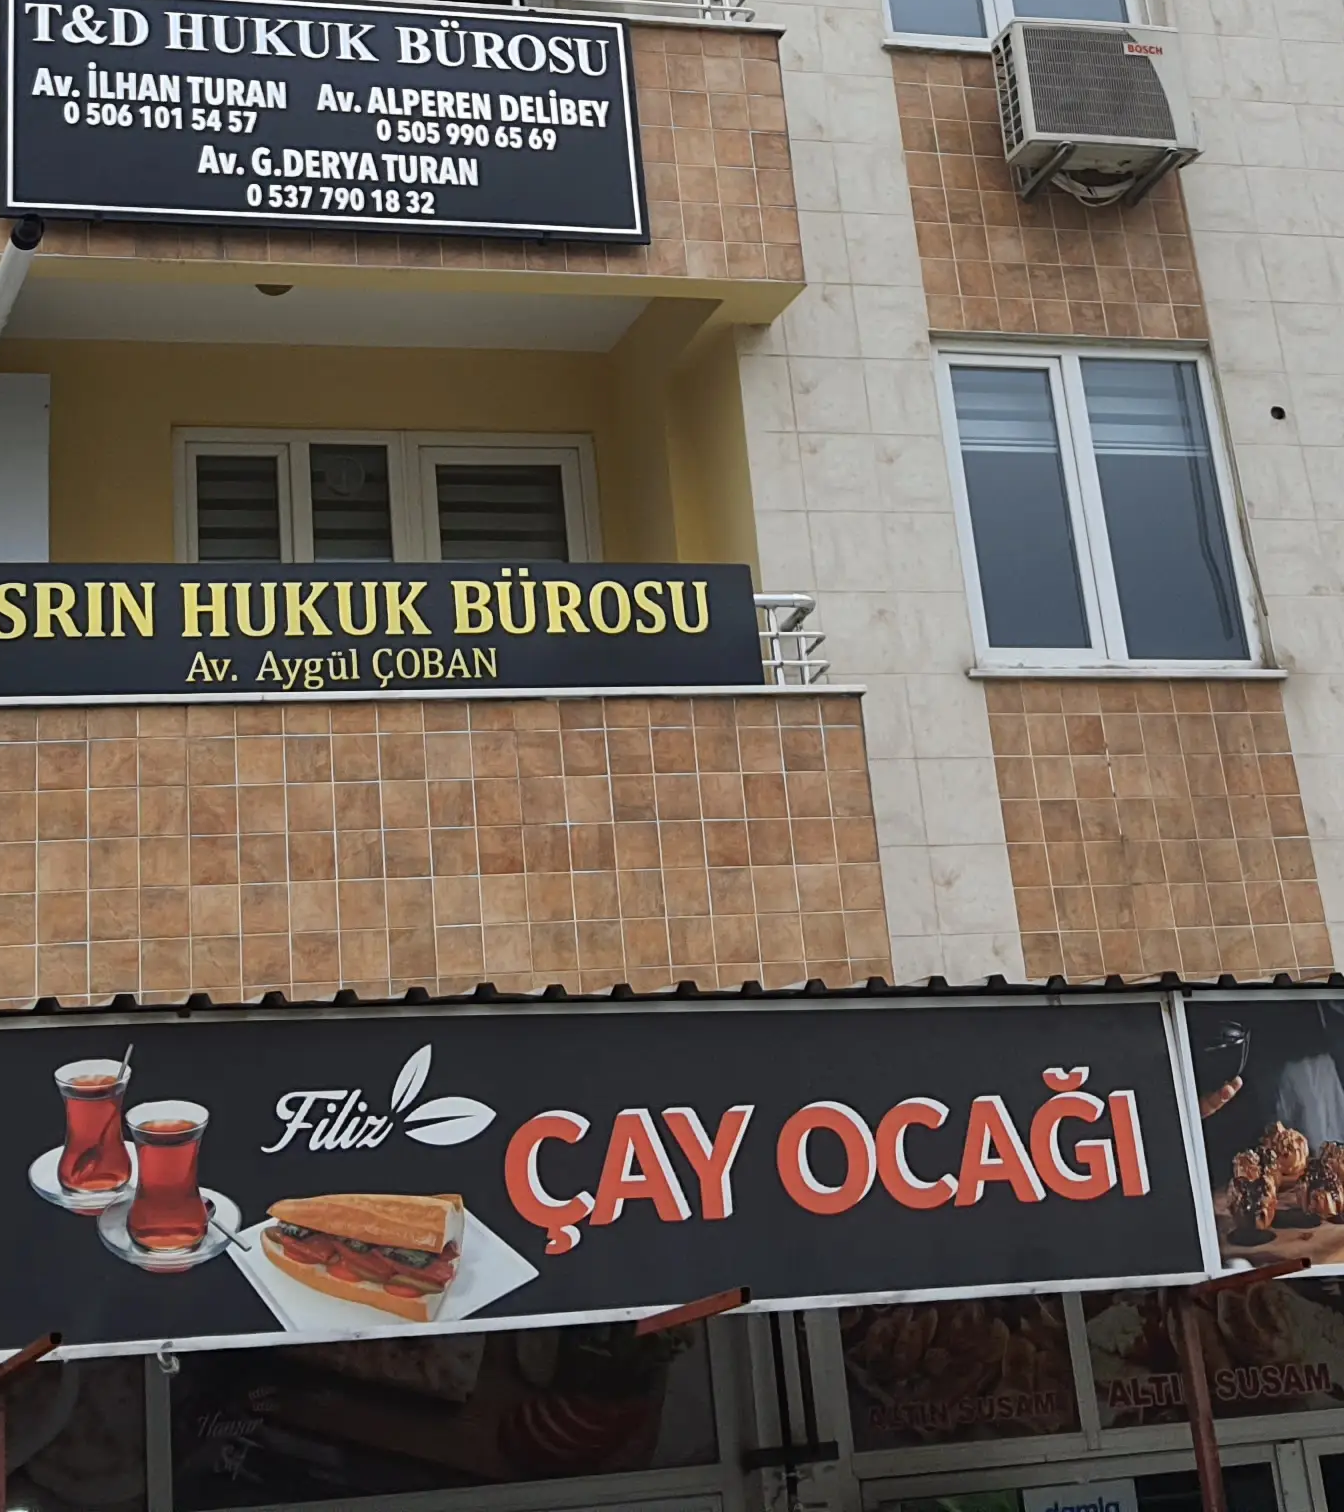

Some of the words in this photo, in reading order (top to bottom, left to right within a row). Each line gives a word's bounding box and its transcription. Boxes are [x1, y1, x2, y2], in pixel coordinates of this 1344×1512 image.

[24, 1, 149, 48] T&D
[163, 10, 380, 63] HUKUK
[395, 18, 610, 77] BÜROSU
[1127, 43, 1164, 56] BOSCH
[31, 66, 81, 99] Av.
[87, 61, 182, 104] İLHAN
[188, 76, 288, 110] TURAN
[316, 84, 362, 114] Av.
[367, 87, 493, 123] ALPEREN
[499, 89, 611, 129] DELİBEY
[63, 103, 80, 125] 0
[85, 104, 133, 129] 506
[138, 105, 184, 131] 101
[191, 108, 223, 133] 54
[227, 110, 258, 135] 57
[376, 119, 392, 142] 0
[397, 119, 444, 144] 505
[447, 122, 490, 147] 990
[494, 125, 523, 149] 65
[527, 127, 558, 152] 69
[197, 144, 246, 176] Av.
[251, 146, 378, 183] G.DERYA
[381, 153, 480, 187] TURAN
[246, 184, 263, 208] 0
[267, 184, 314, 210] 537
[319, 187, 365, 213] 790
[370, 189, 401, 214] 18
[406, 191, 436, 216] 32
[179, 579, 433, 639] HUKUK
[448, 567, 711, 637] BÜROSU
[184, 650, 241, 683] Av.
[254, 647, 360, 691] Aygül
[370, 646, 500, 689] ÇOBAN
[260, 1088, 396, 1157] Filiz
[503, 1103, 756, 1255] ÇAY
[775, 1064, 1151, 1218] OCAĞI
[956, 1391, 1057, 1423] SUSAM
[1107, 1374, 1186, 1409] ALTI
[1214, 1363, 1333, 1403] SUSAM
